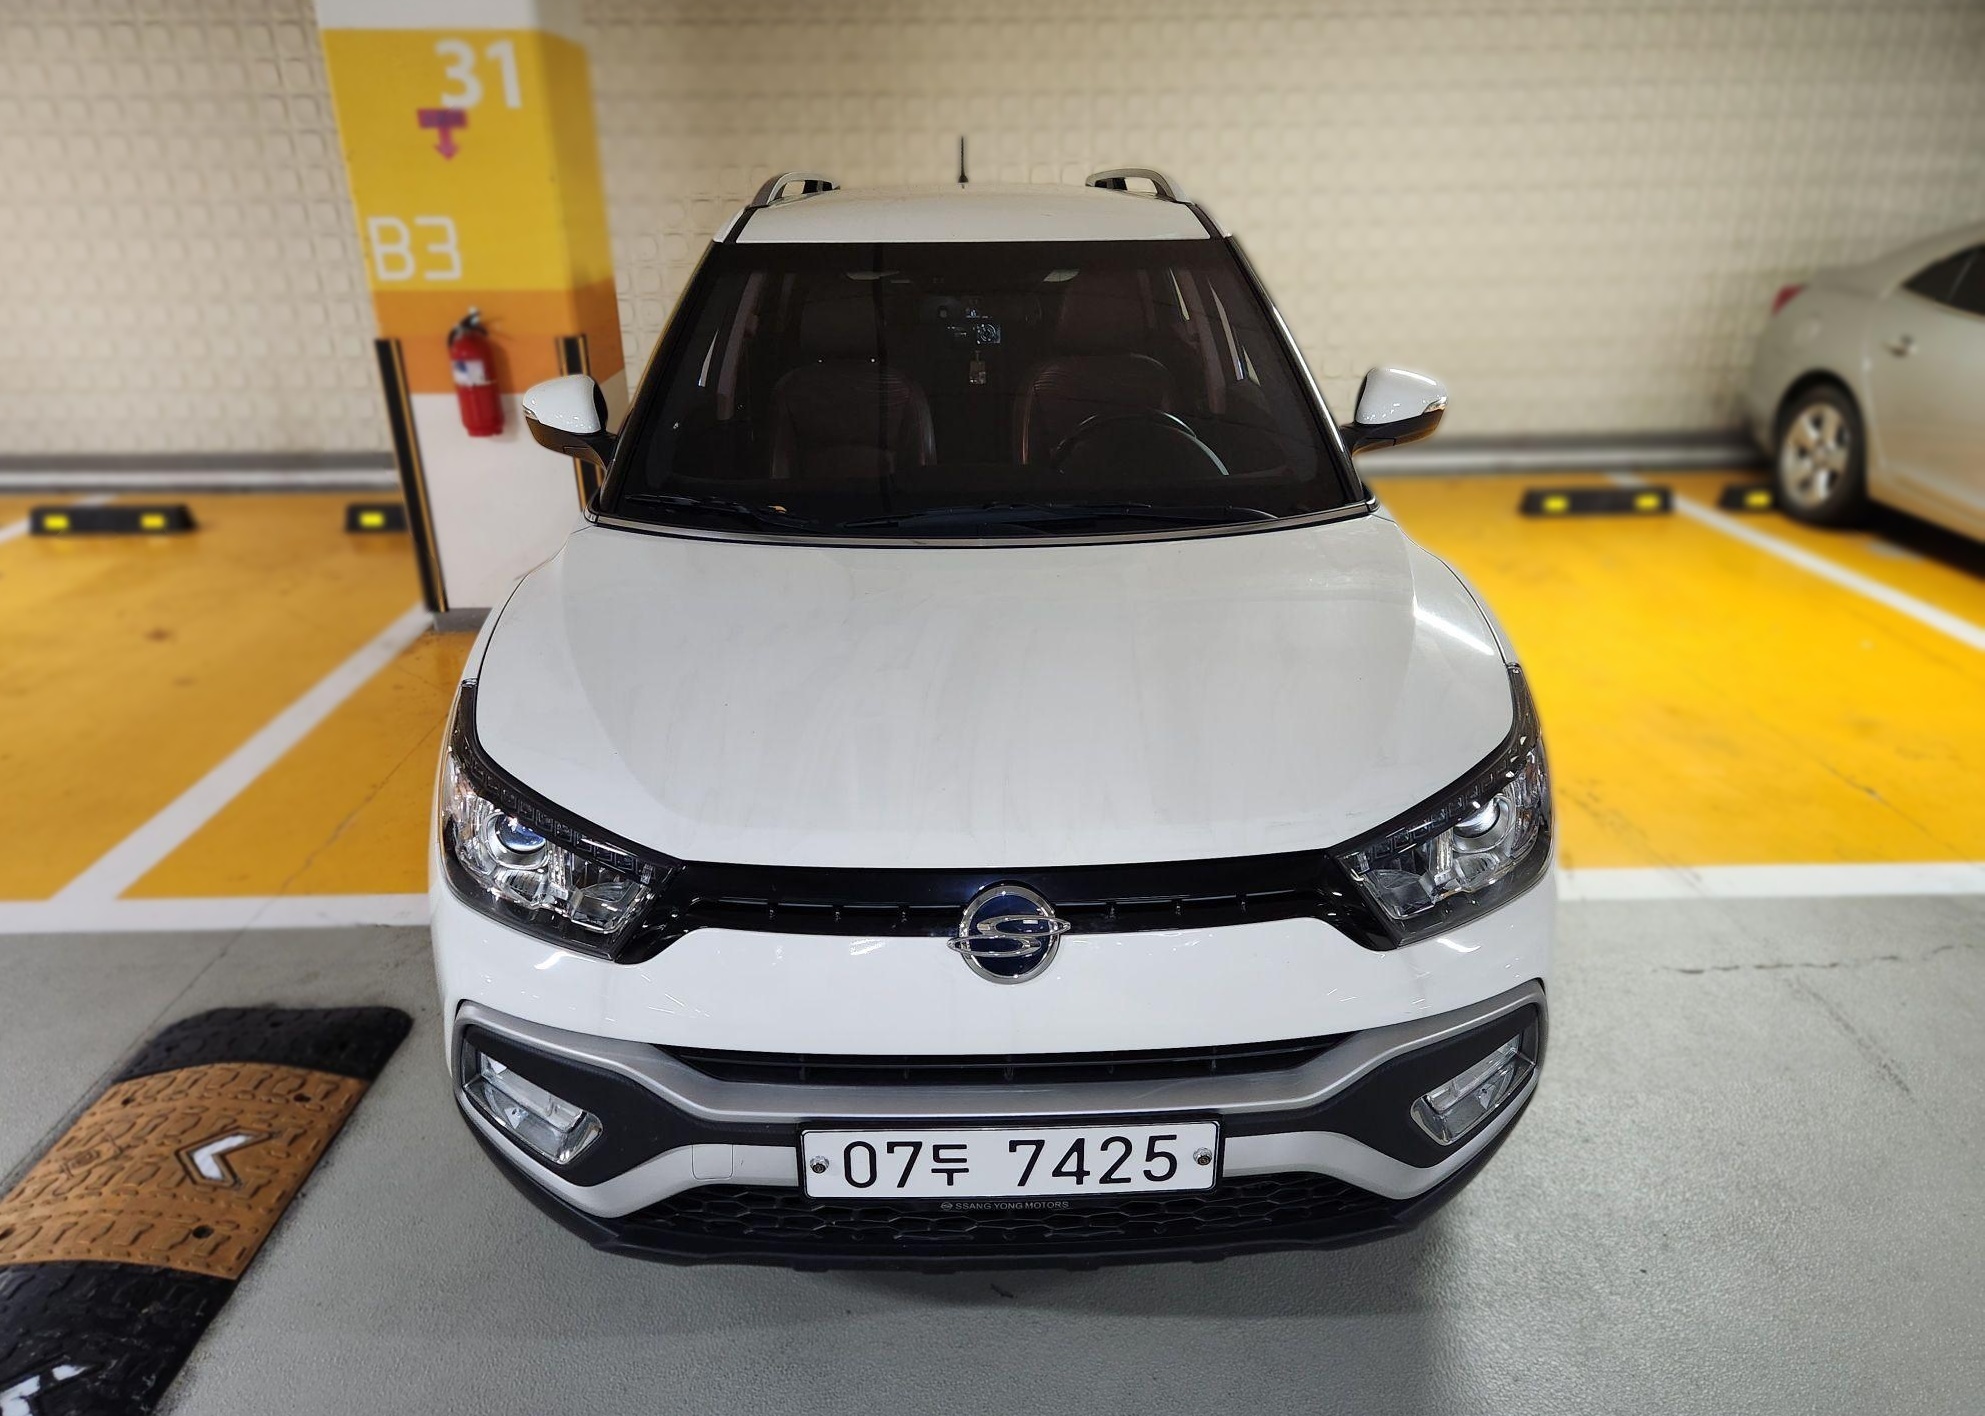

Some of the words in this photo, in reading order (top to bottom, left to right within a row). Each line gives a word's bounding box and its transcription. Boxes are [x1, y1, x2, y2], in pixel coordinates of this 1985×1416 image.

[434, 39, 523, 110] 31
[367, 215, 463, 281] B3
[843, 1140, 970, 1189] 07두
[1008, 1134, 1178, 1188] 7425
[955, 1202, 992, 1210] SSANG
[993, 1202, 1023, 1210] YONG
[1025, 1201, 1069, 1209] MOTORS
